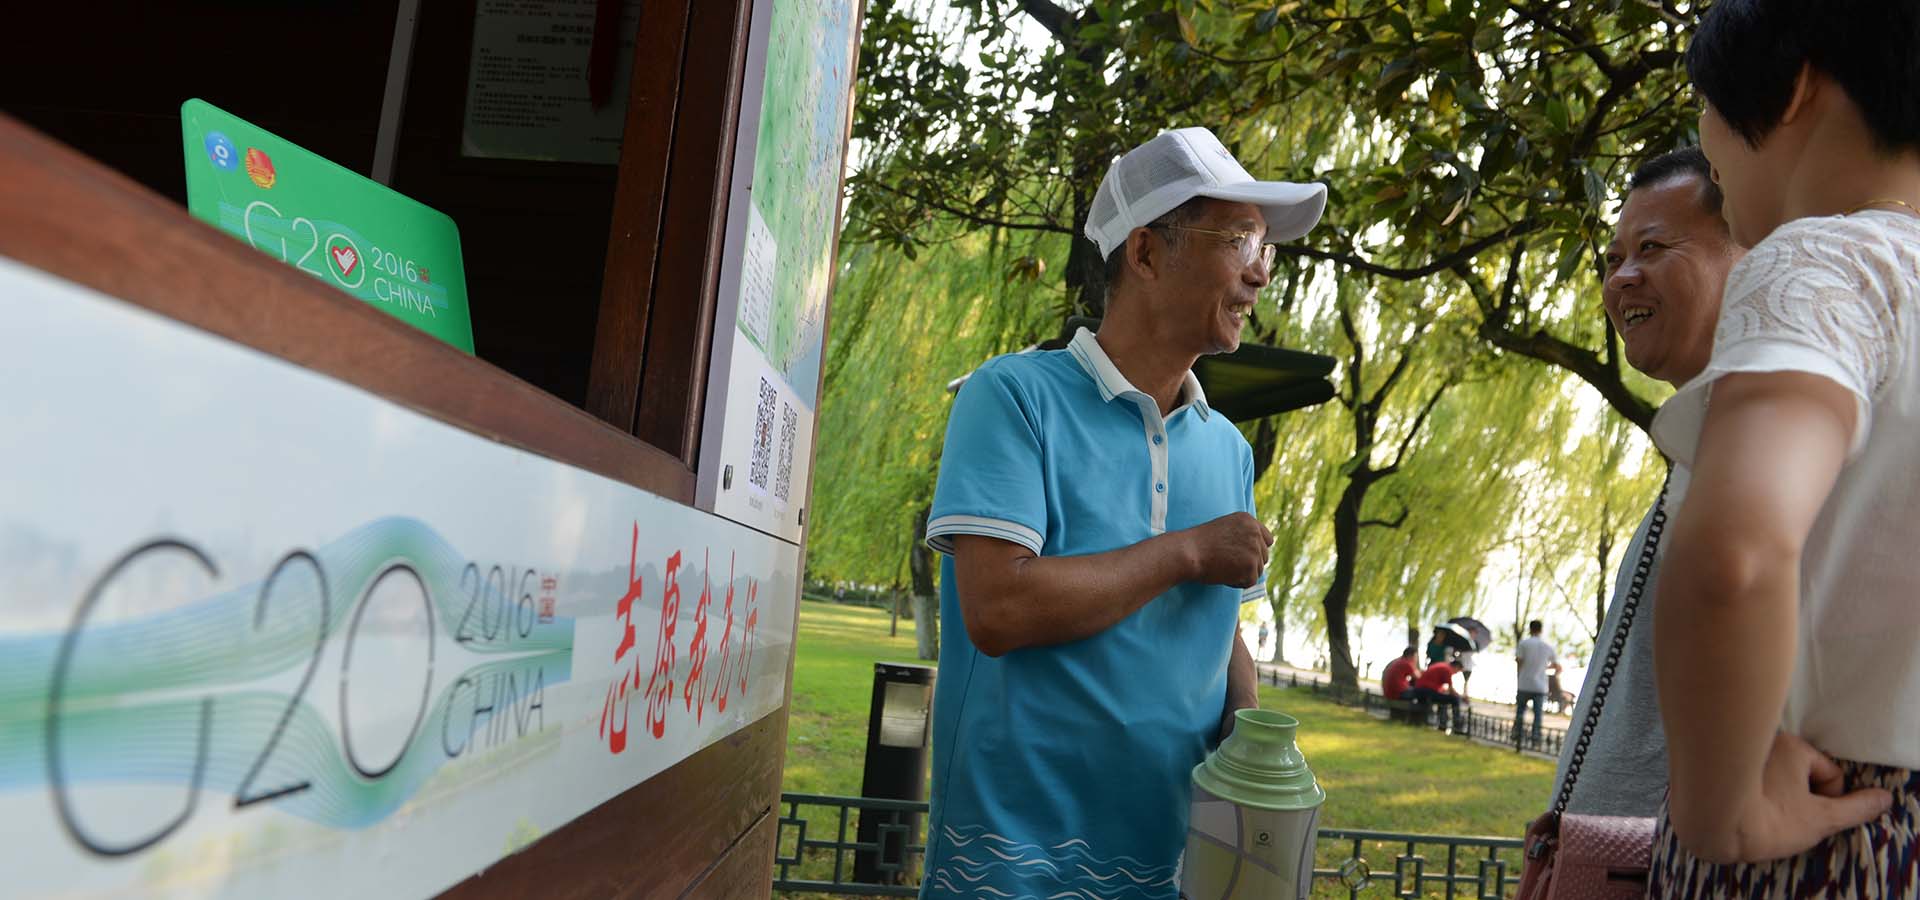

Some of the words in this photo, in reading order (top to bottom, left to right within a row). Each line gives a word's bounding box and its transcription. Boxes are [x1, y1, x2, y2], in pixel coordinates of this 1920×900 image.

[244, 200, 365, 289] G20
[371, 246, 417, 282] 2016
[374, 277, 436, 318] CHINA
[455, 561, 536, 641] 2016
[599, 519, 758, 755] 志愿我先行
[45, 535, 436, 860] G20
[441, 666, 544, 758] CHINA
